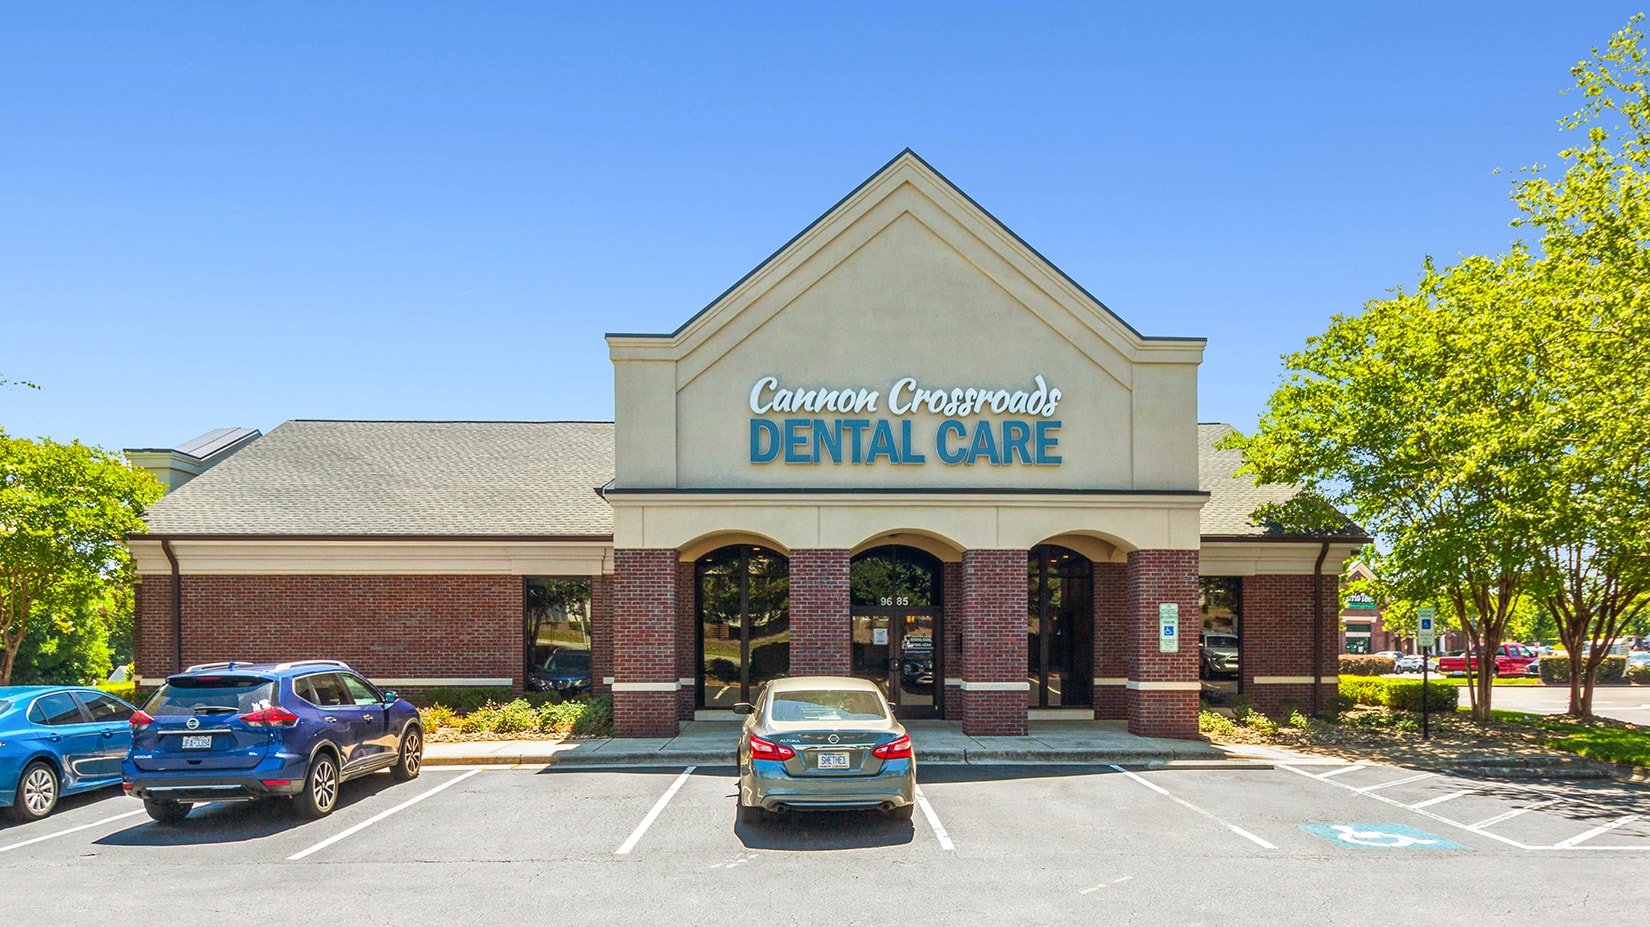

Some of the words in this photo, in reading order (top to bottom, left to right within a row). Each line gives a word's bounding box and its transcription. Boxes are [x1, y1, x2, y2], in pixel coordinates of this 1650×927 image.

[749, 376, 880, 415] Cannon
[888, 374, 1063, 417] Crossroads
[750, 418, 926, 465] DENTAL
[936, 419, 1063, 465] CARE
